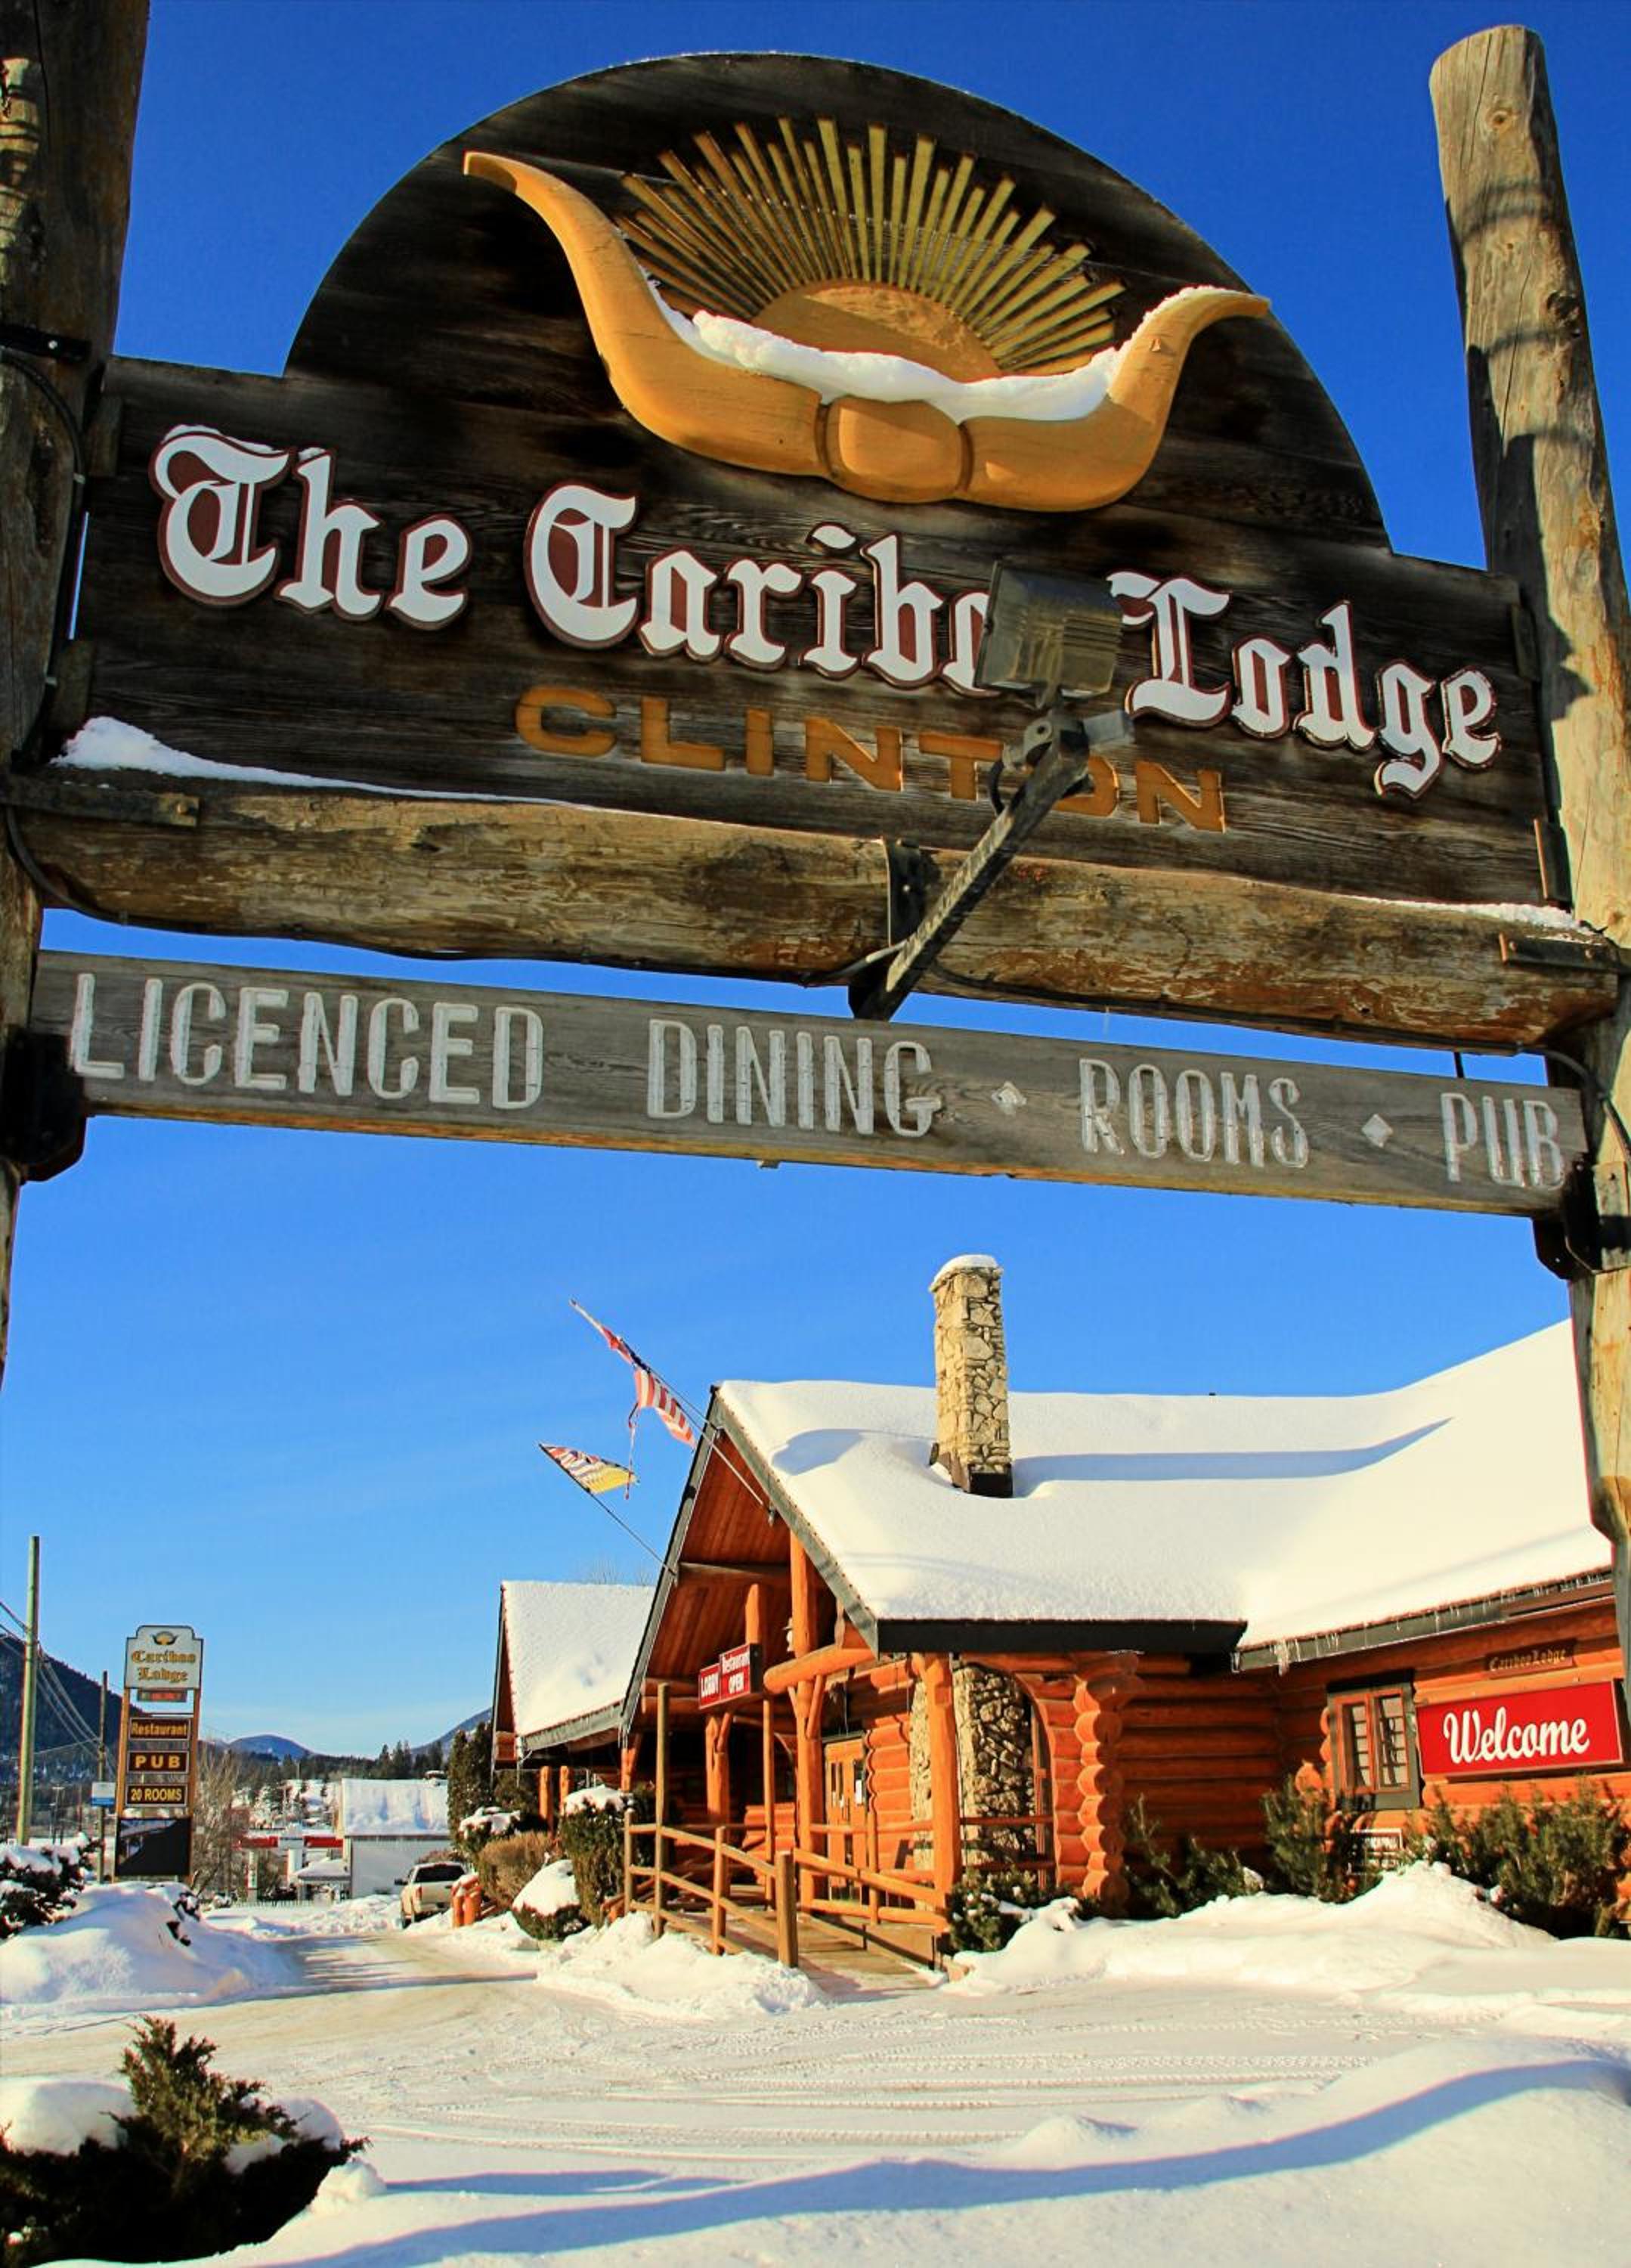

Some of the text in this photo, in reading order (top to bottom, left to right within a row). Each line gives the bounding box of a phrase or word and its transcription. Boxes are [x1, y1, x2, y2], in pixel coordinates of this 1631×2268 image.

[150, 432, 1502, 799] The Caribo Lodge
[69, 973, 1565, 1191] LICENCED DINING ROOMS PUB
[131, 1650, 196, 1664] Cariboo
[138, 1666, 188, 1684] Lodge
[701, 1672, 720, 1698] LOBBY
[728, 1672, 744, 1694] OPEN
[131, 1722, 187, 1737] Restaurant
[1444, 1706, 1590, 1765] Welcome
[135, 1754, 181, 1769] PUB
[131, 1787, 183, 1802] 20 ROOMS
